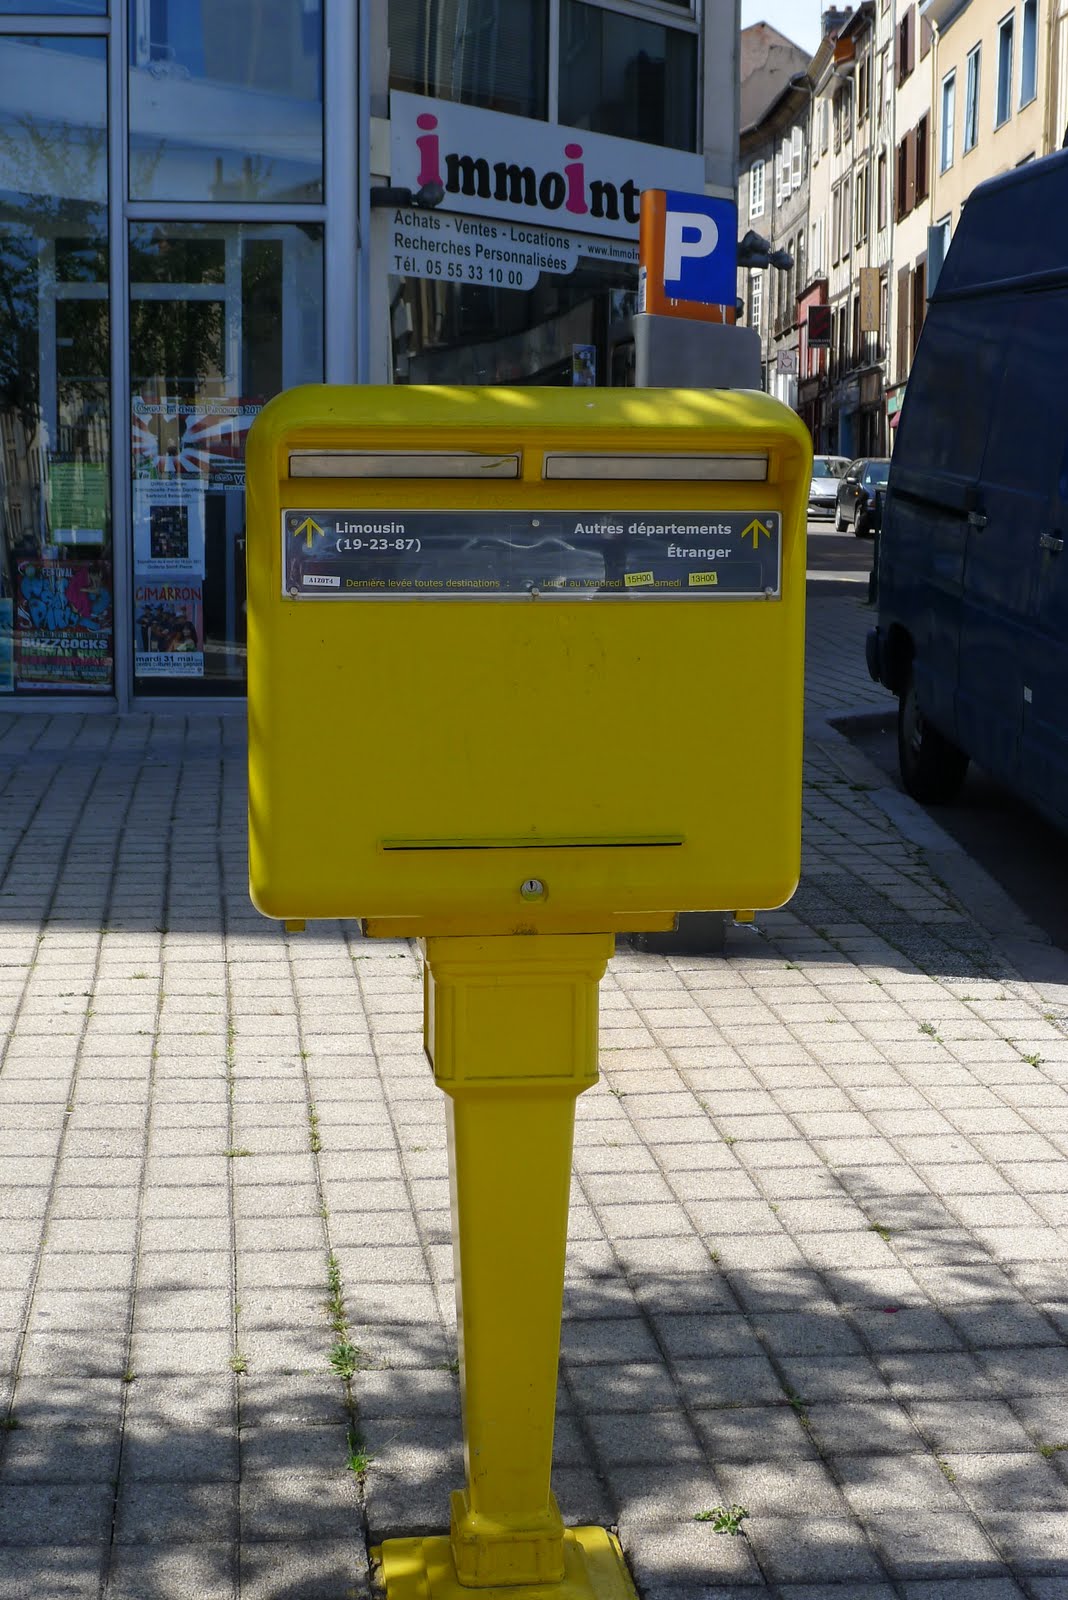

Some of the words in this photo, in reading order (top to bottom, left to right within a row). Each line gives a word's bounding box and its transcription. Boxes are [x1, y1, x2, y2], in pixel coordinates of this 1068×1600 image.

[394, 210, 441, 230] Achats
[455, 218, 497, 239] Ventes
[510, 229, 570, 249] Locations
[394, 232, 471, 257] Recherches
[475, 244, 567, 270] Personnalisées
[664, 211, 718, 281] P
[394, 255, 420, 272] Tél.
[426, 259, 441, 275] 05
[447, 262, 463, 278] 55
[468, 265, 483, 281] 33
[489, 268, 503, 284] 10
[508, 270, 523, 286] 00
[335, 522, 405, 534] Limousin
[574, 523, 624, 534] Autres
[628, 522, 732, 537] départements
[336, 538, 421, 553] (19-23-87)
[667, 543, 732, 560] Étranger
[346, 576, 386, 587] Dernière
[388, 577, 412, 587] levée
[414, 578, 444, 587] toutes
[446, 578, 500, 587] destinations
[584, 579, 623, 587] Vendredi
[627, 573, 651, 584] 15H00
[690, 574, 715, 583] 13H00
[136, 585, 202, 601] CIMARRON
[22, 638, 108, 648] BUZZCOCKS
